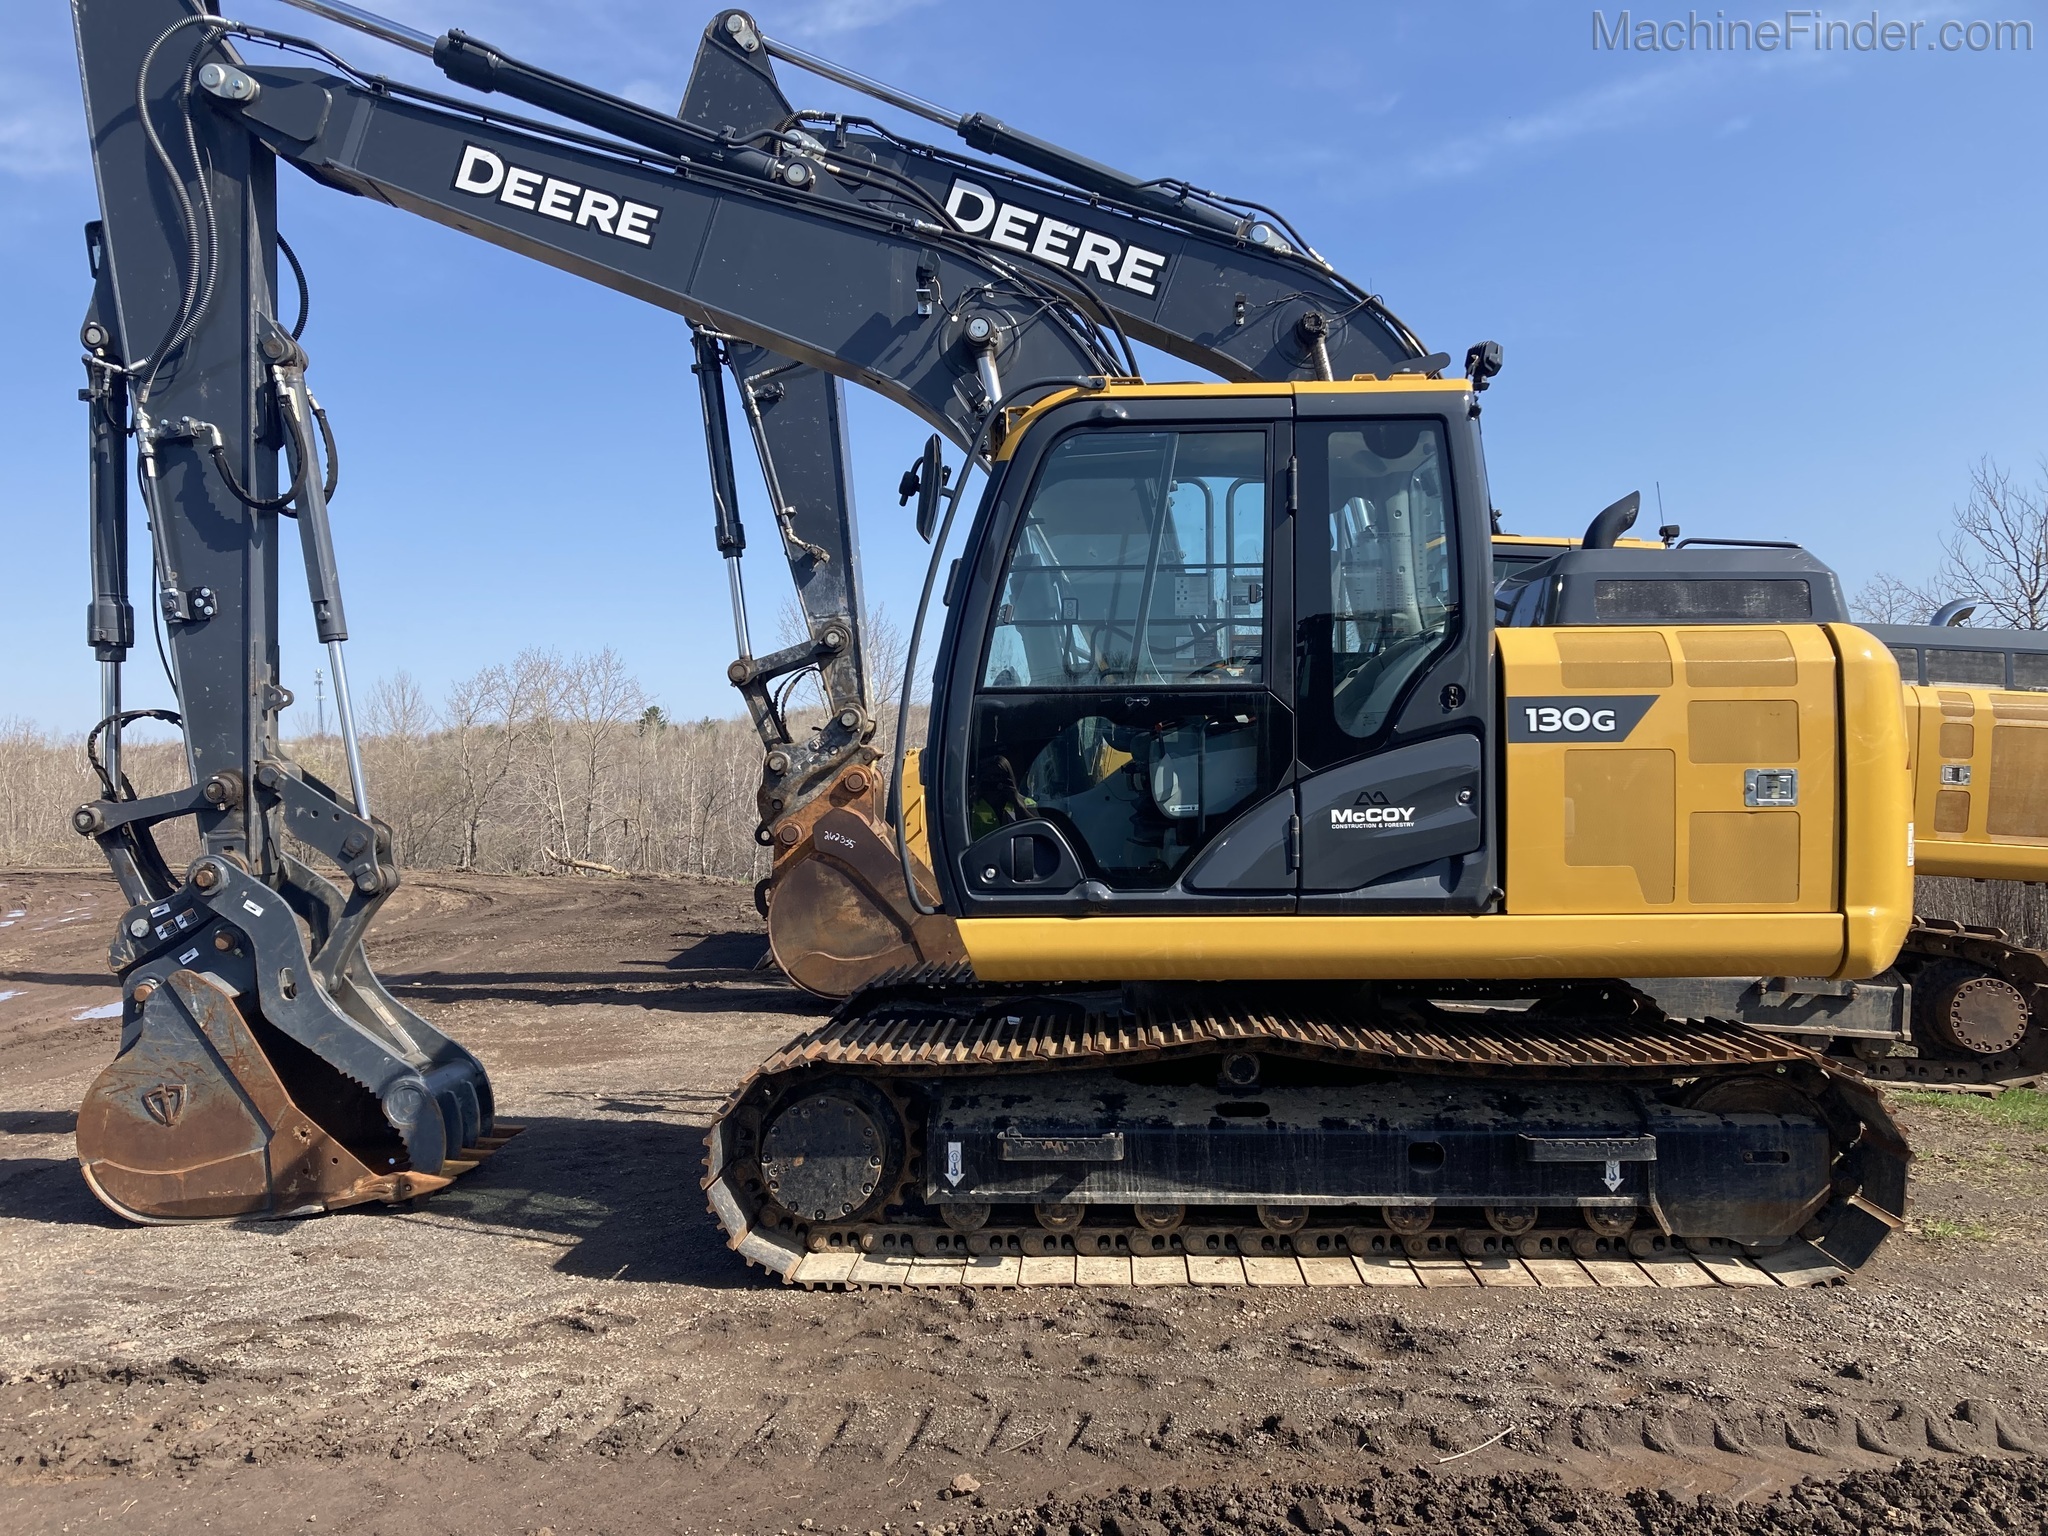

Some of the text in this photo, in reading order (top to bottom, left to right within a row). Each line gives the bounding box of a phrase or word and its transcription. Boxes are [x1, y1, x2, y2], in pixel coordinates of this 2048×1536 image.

[455, 145, 659, 245] DEERE
[945, 178, 1166, 295] DEERE
[1525, 707, 1616, 732] 130G
[1331, 807, 1415, 823] McCOY
